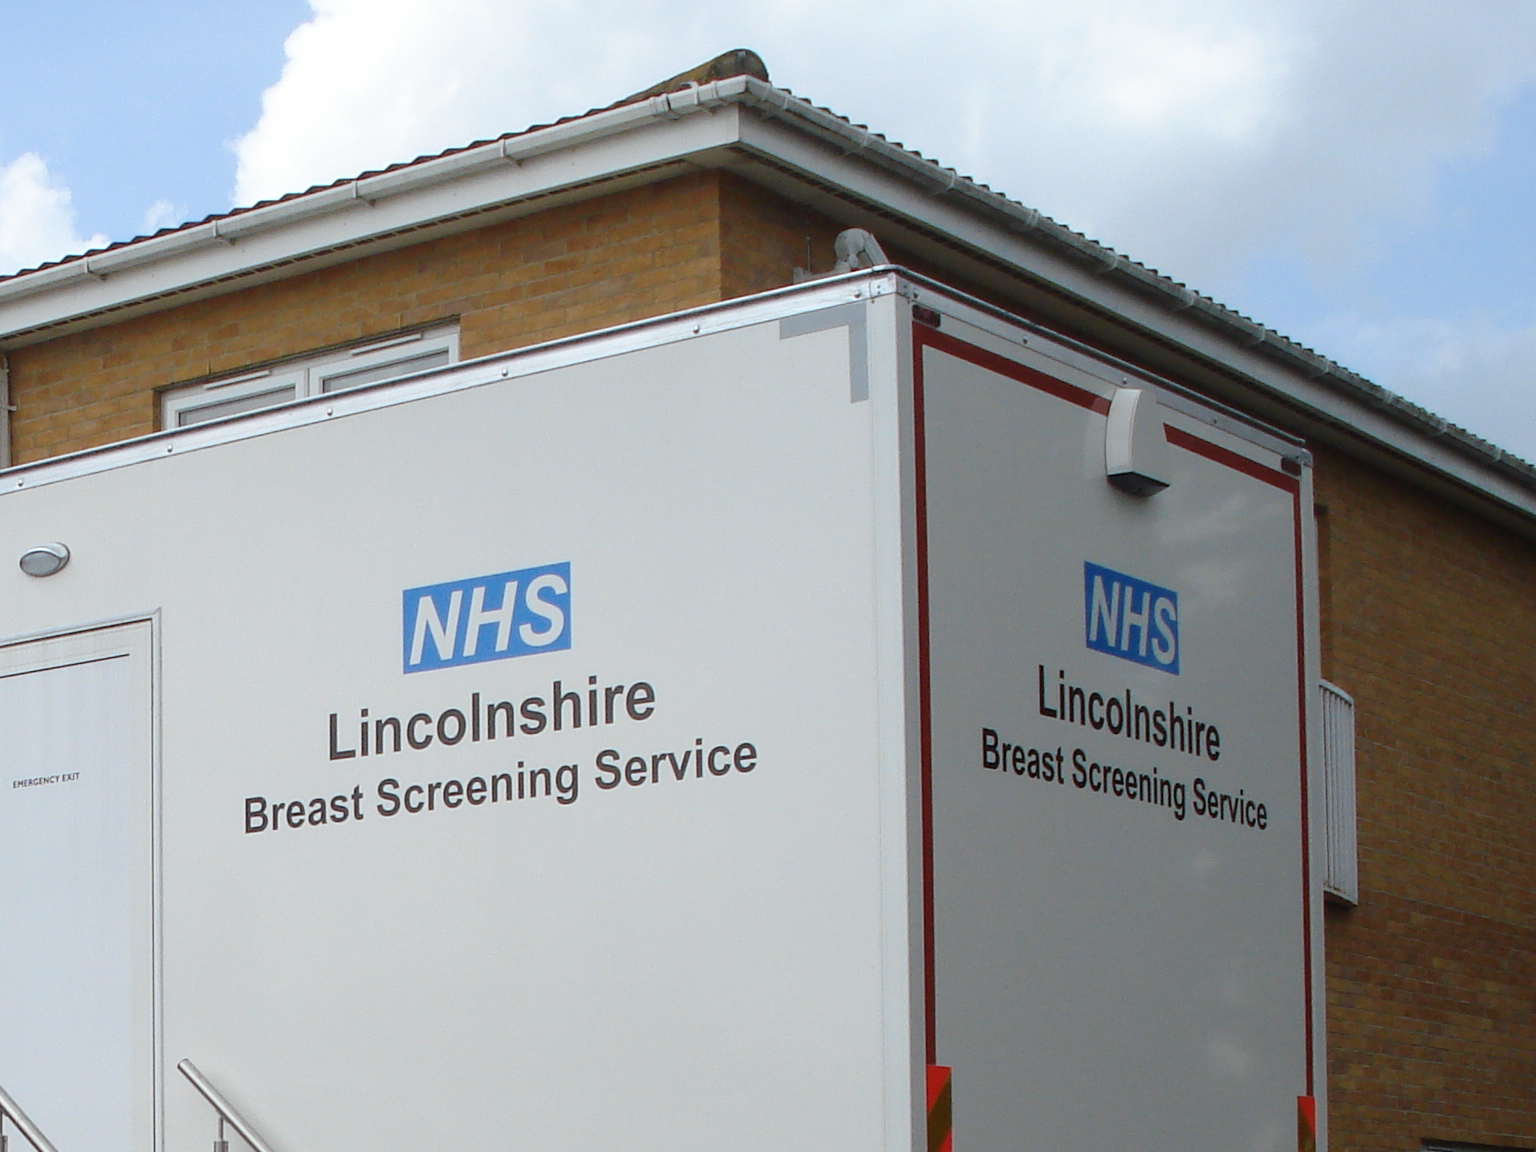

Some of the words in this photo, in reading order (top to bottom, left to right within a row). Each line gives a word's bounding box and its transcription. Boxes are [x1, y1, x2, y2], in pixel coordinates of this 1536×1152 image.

[409, 574, 568, 666] NHS
[1089, 575, 1176, 665] NHS
[329, 676, 655, 760] Lincolnshire
[1038, 664, 1220, 761] Lincolnshire
[13, 775, 60, 788] EMERGENCY
[62, 772, 80, 782] EXIT
[244, 784, 364, 834] Breast
[376, 761, 579, 818] Screening
[595, 738, 758, 790] Service
[982, 727, 1064, 784] Breast
[1072, 748, 1186, 821] Screening
[1193, 777, 1268, 830] Service
